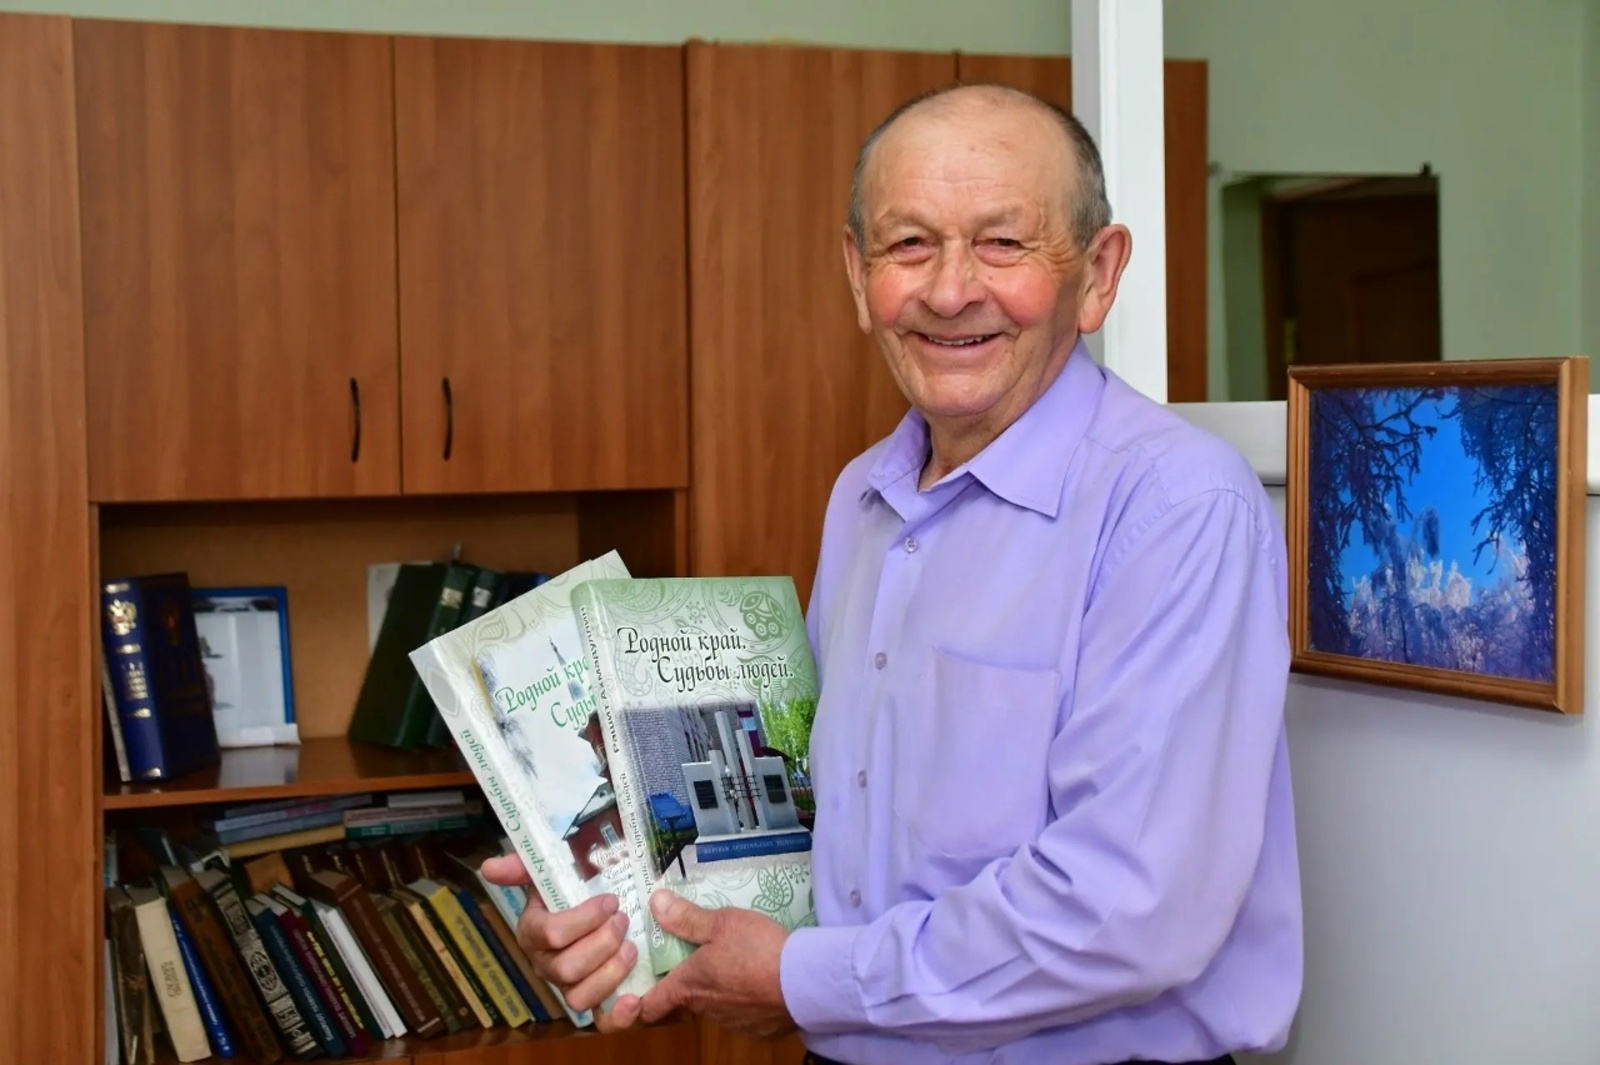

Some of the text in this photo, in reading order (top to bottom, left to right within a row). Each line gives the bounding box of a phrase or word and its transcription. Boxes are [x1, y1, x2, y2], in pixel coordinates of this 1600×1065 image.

[616, 626, 747, 664] Родной край.
[494, 656, 589, 714] Родной кра
[580, 606, 620, 754] Рашит Ахмадуллин
[657, 655, 794, 693] Судьбы людей.
[487, 774, 522, 833] Судьбы
[519, 834, 546, 874] край.
[541, 877, 571, 913] дной
